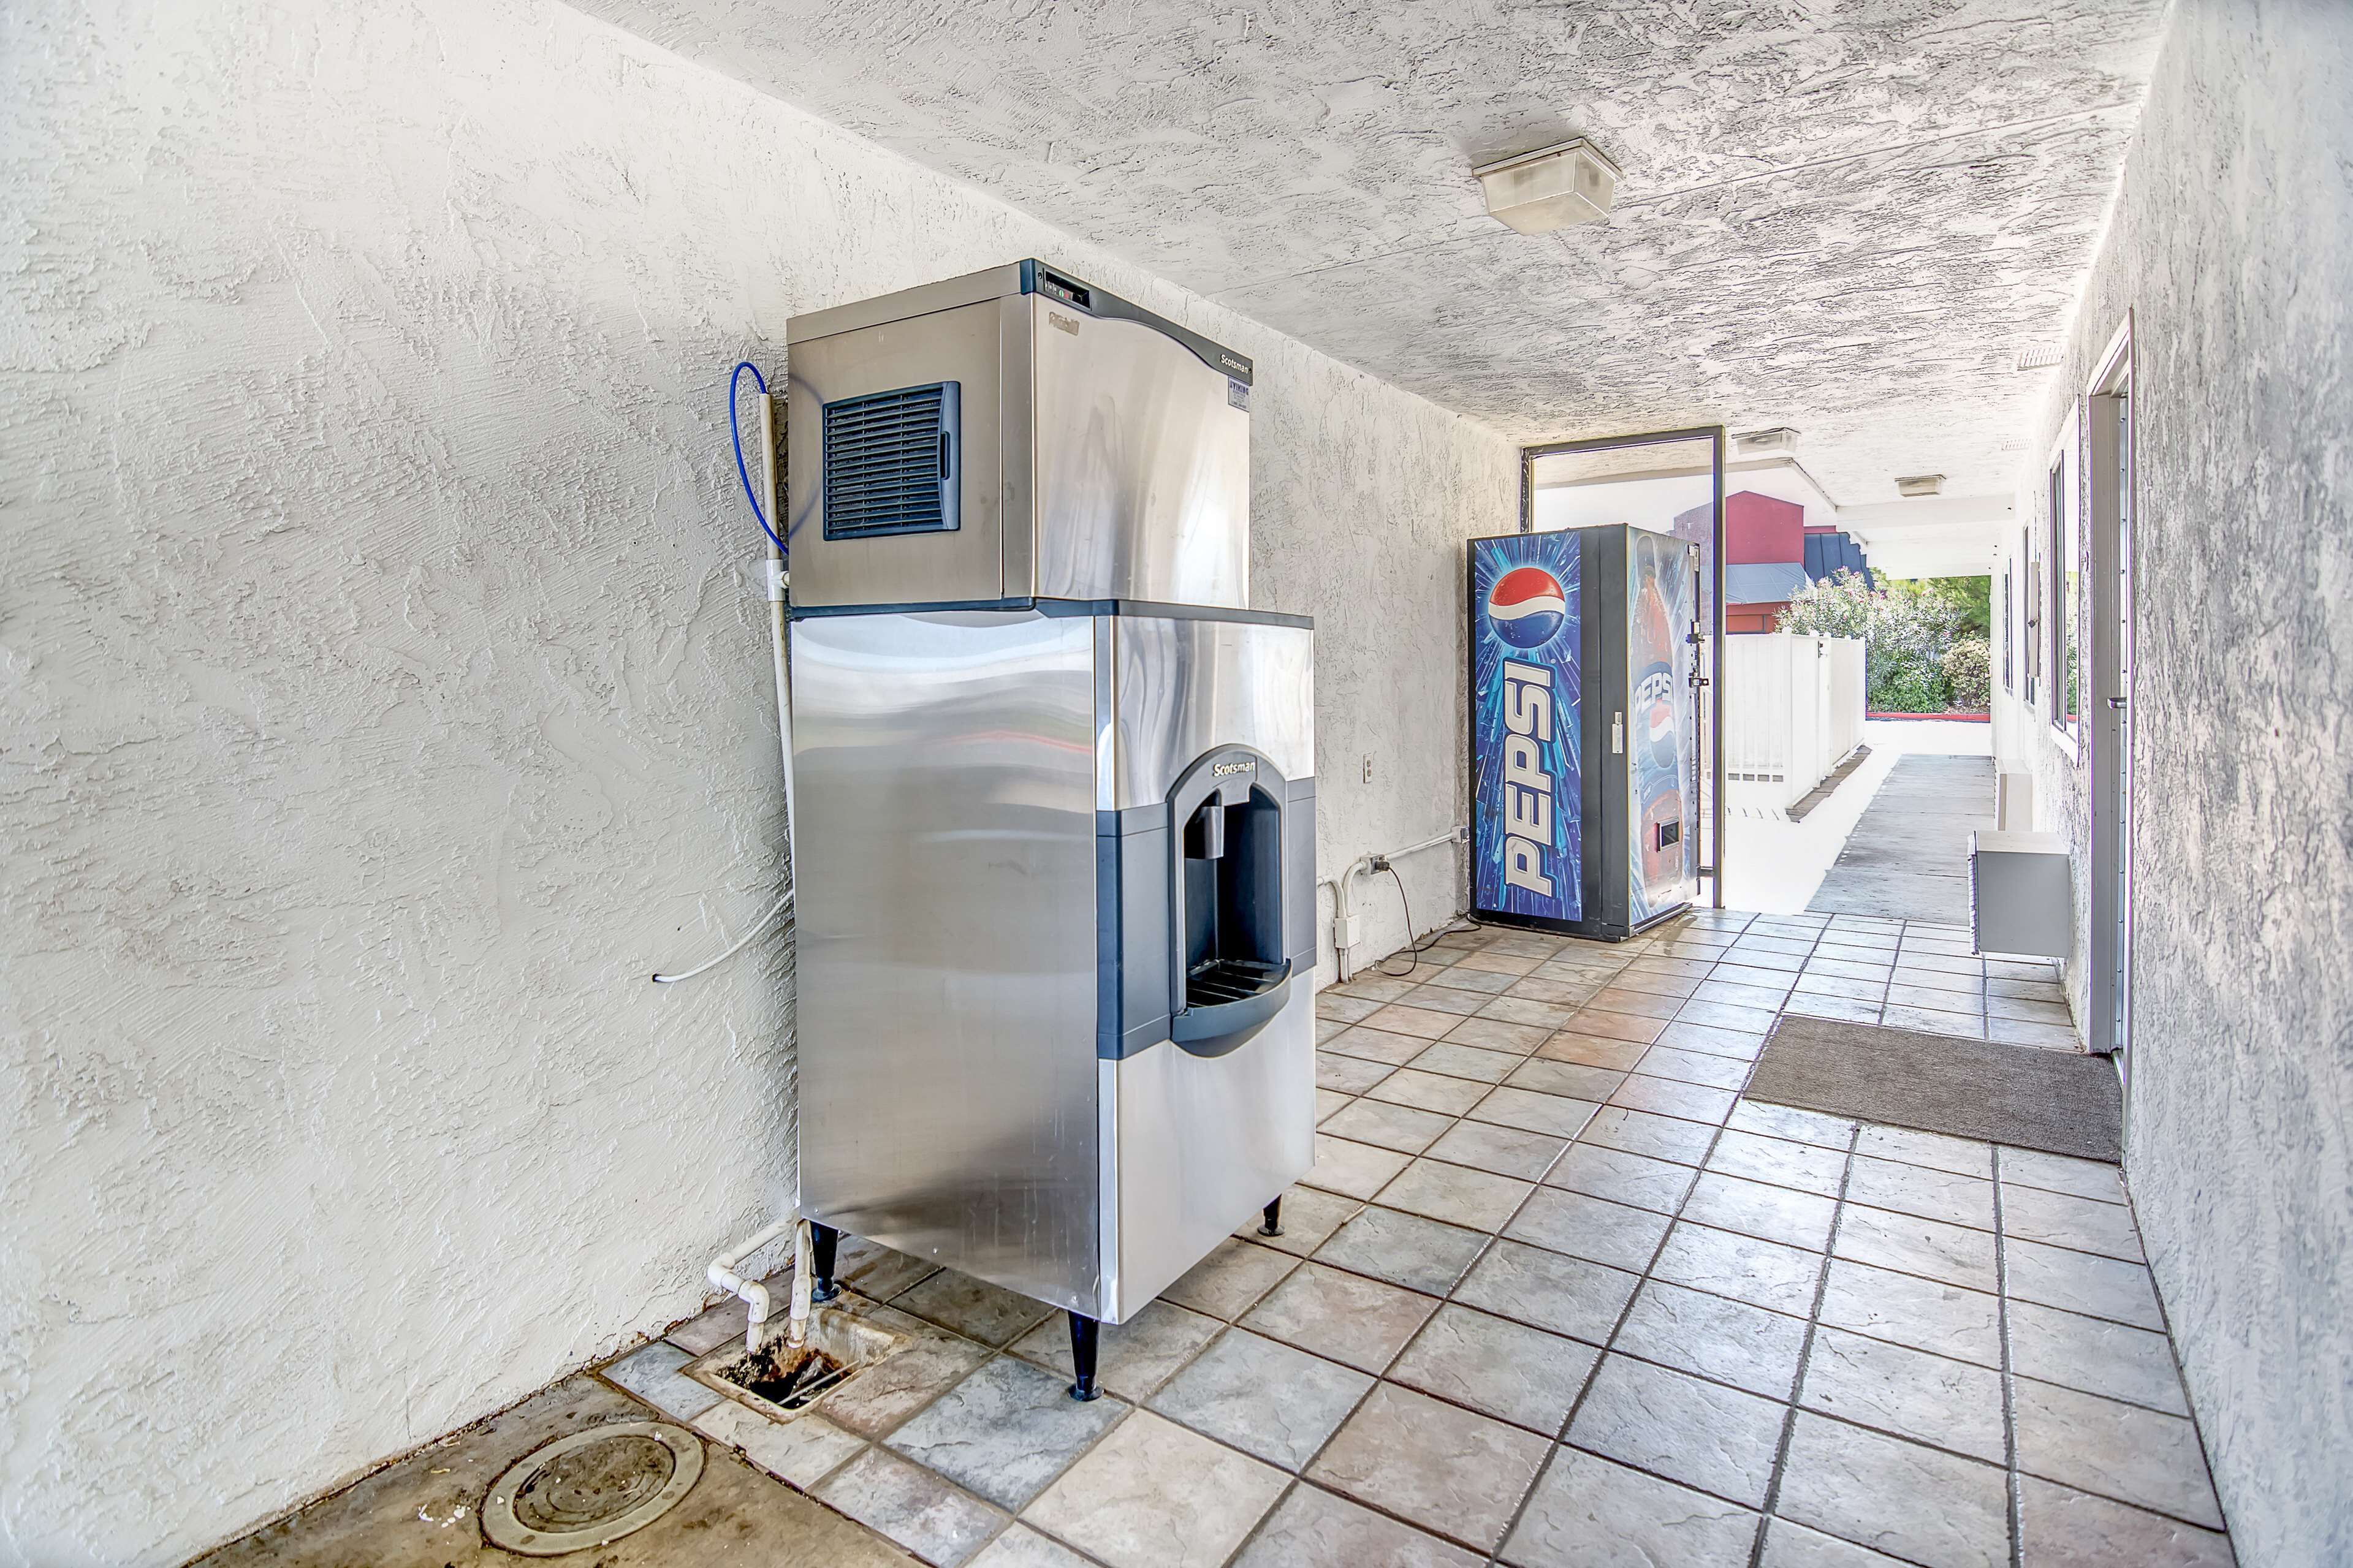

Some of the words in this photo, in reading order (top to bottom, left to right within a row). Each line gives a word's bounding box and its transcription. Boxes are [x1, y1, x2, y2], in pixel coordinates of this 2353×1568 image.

[1220, 354, 1248, 374] Scotsman
[1634, 672, 1673, 715] PEPS
[1214, 762, 1255, 777] Scotsman
[1505, 661, 1552, 898] PEPSI
